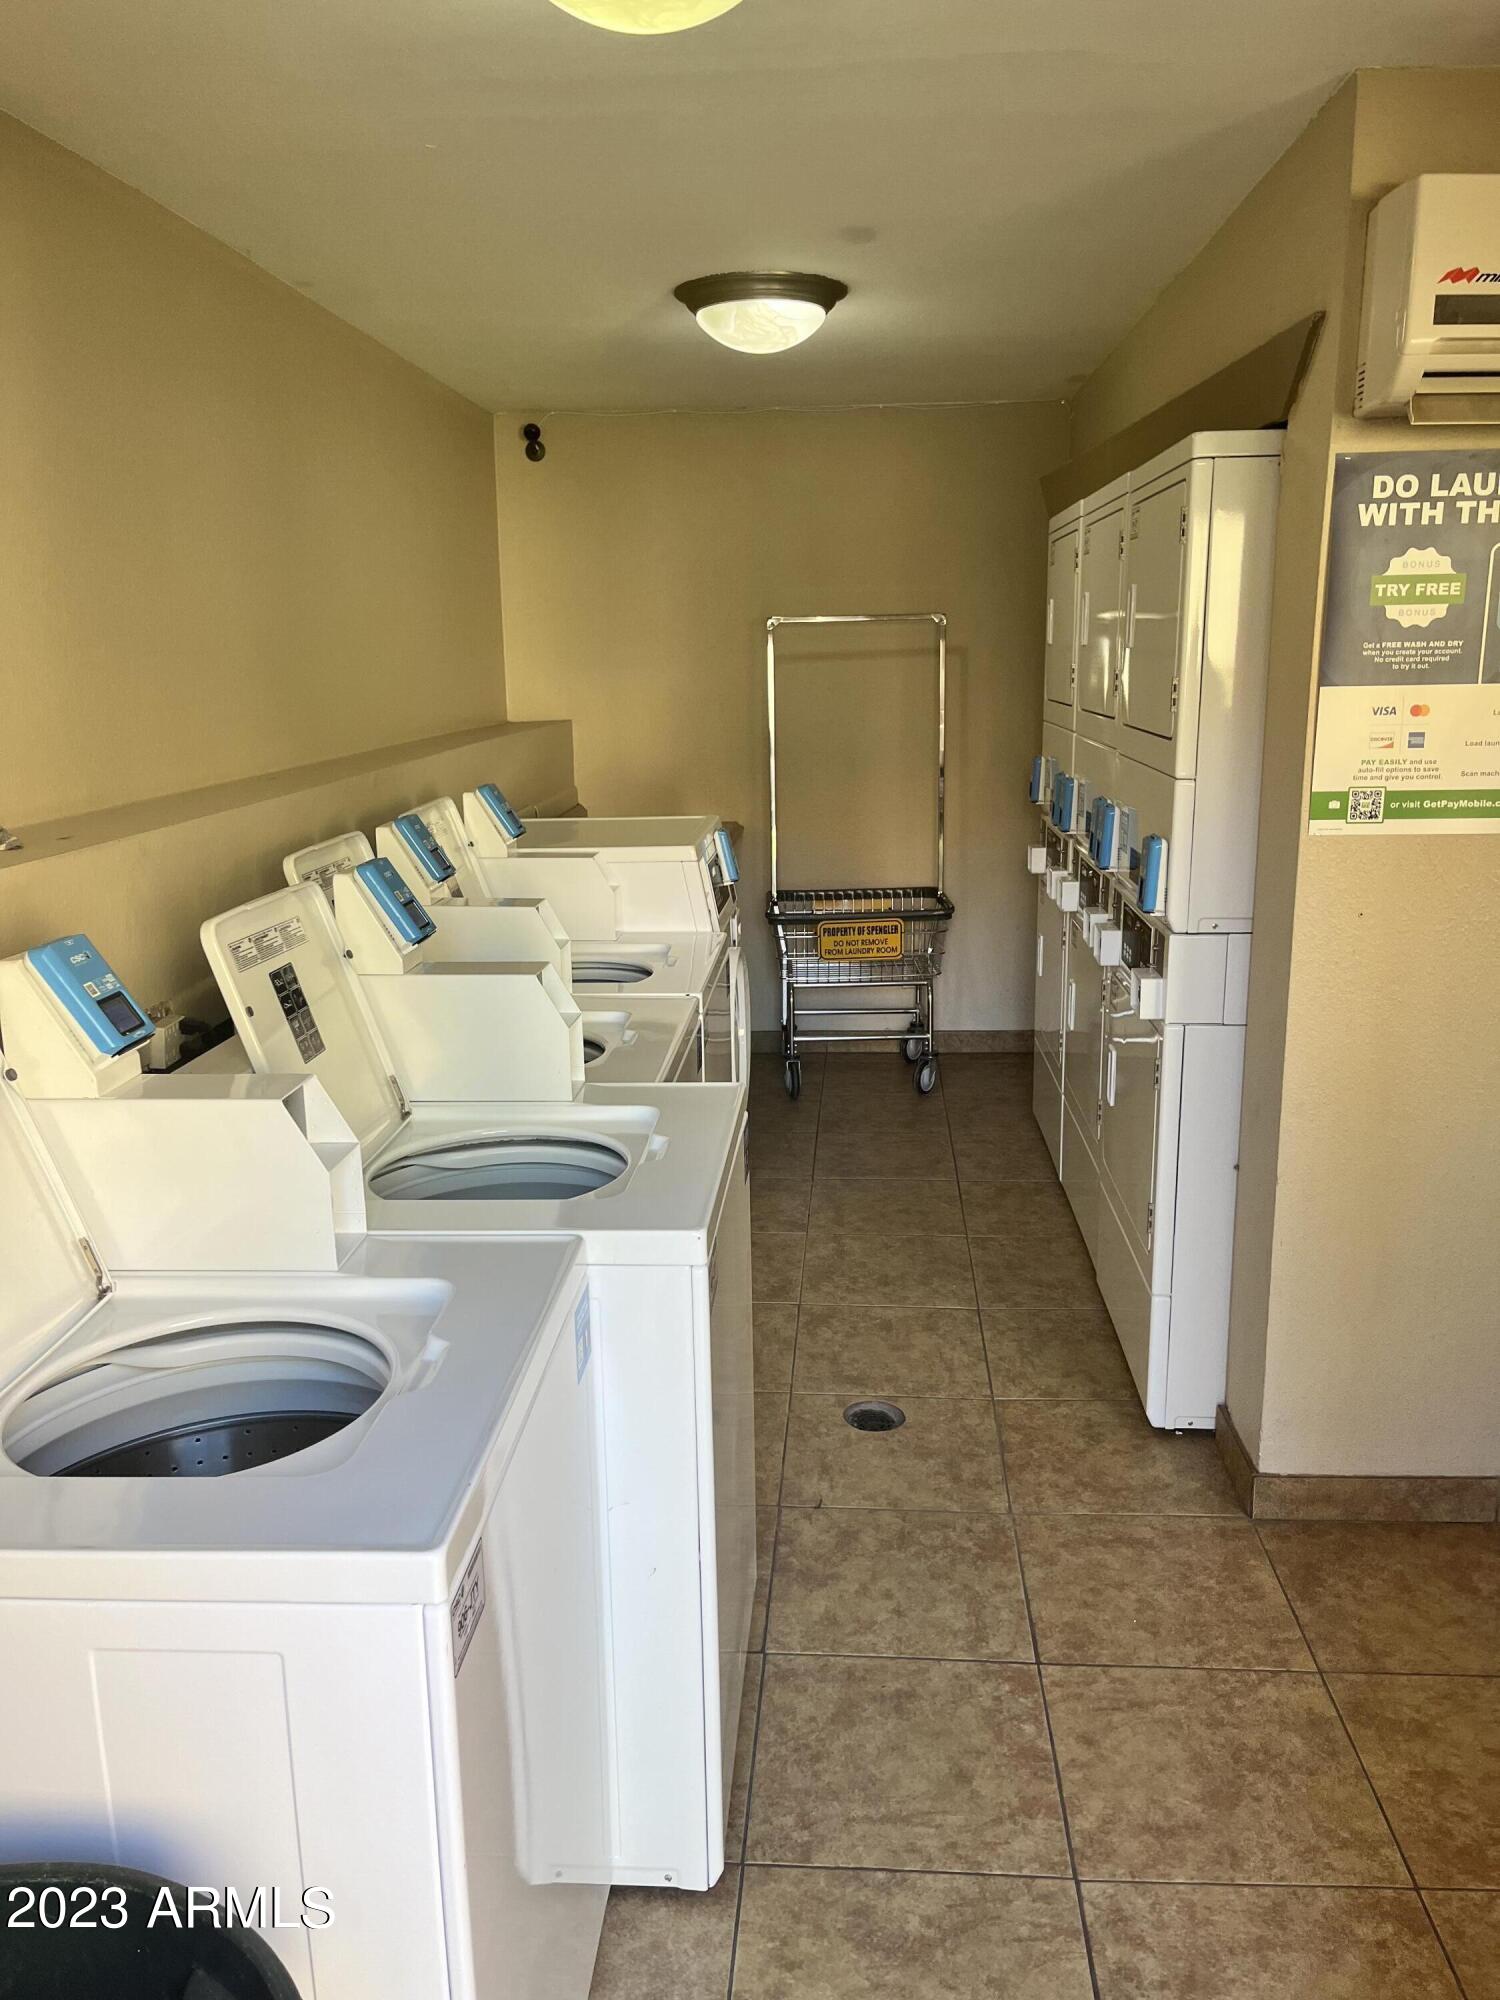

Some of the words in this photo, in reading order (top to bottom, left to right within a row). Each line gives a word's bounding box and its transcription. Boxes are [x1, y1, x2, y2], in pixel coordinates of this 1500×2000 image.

[1373, 474, 1419, 499] DO
[1431, 472, 1500, 498] LAU
[1358, 501, 1444, 527] WITH
[1456, 499, 1500, 524] TH
[1402, 560, 1441, 569] BONUS
[1375, 583, 1410, 597] TRY
[1415, 582, 1461, 596] FREE
[1398, 608, 1437, 617] BONUS
[1421, 655, 1450, 663] required
[1372, 706, 1397, 716] VISA
[1401, 800, 1421, 809] visit
[823, 926, 856, 937] PROPERTY
[857, 926, 865, 936] OF
[866, 924, 898, 935] SPENGLER
[861, 938, 888, 946] REMOVE
[824, 948, 844, 956] FROM
[845, 947, 875, 955] LAUNDRY
[876, 946, 898, 954] ROOM
